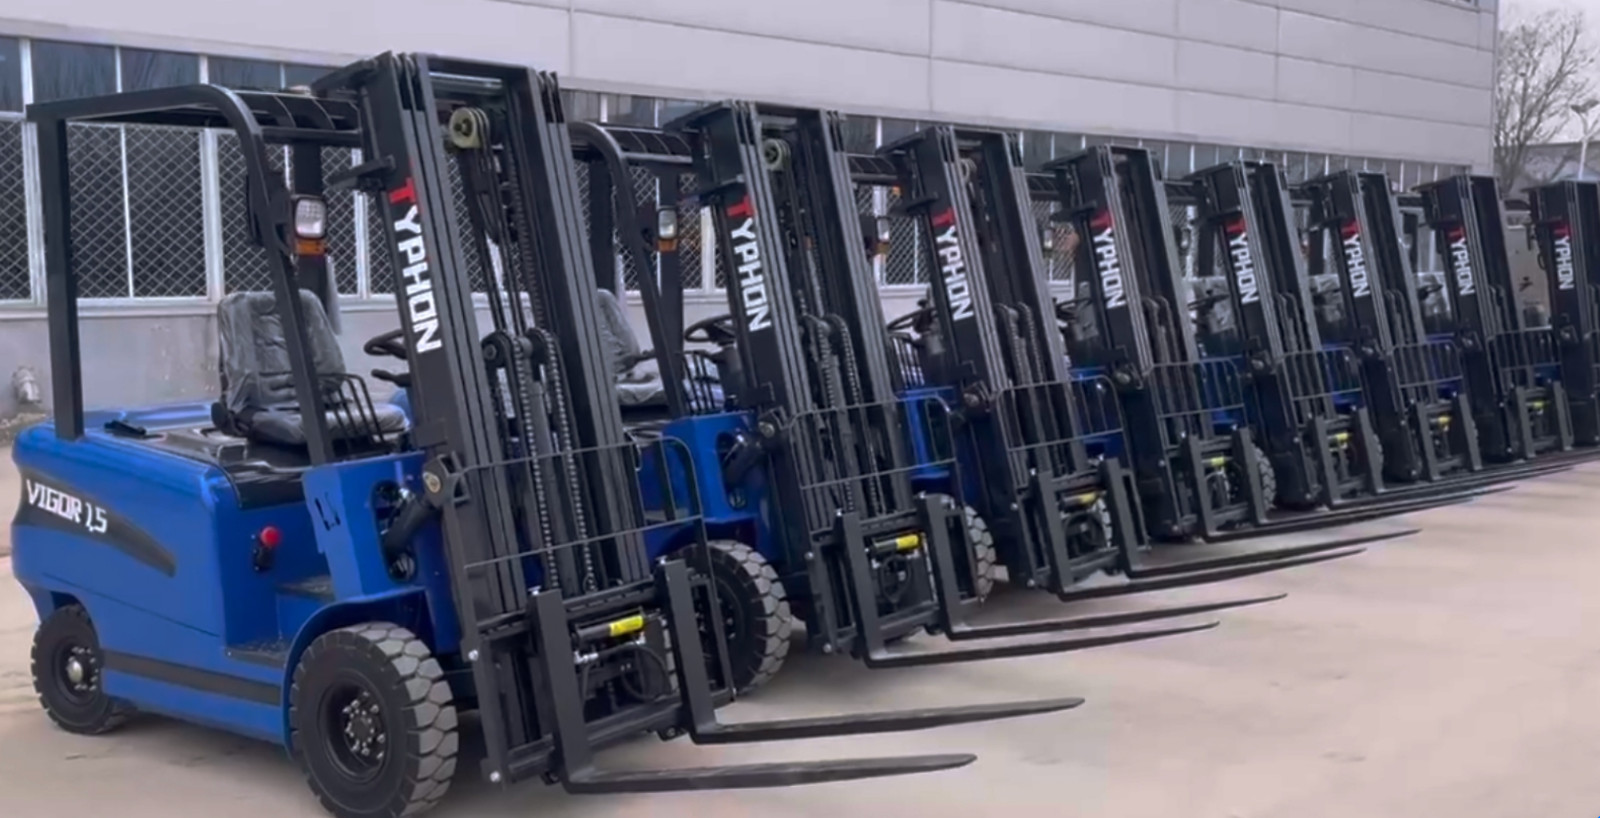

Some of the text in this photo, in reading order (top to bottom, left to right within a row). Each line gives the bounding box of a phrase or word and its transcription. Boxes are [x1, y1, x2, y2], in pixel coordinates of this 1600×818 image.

[389, 177, 443, 354] TYPHON
[726, 194, 771, 332] TYPHON
[931, 206, 974, 321] TYPHON
[1090, 209, 1126, 309] TYPHON
[1226, 217, 1259, 305] TYPHON
[1341, 217, 1370, 298] TYPHON
[1448, 225, 1475, 296] TYPHON
[1554, 222, 1574, 290] TYPHON
[26, 479, 82, 523] VIGOR
